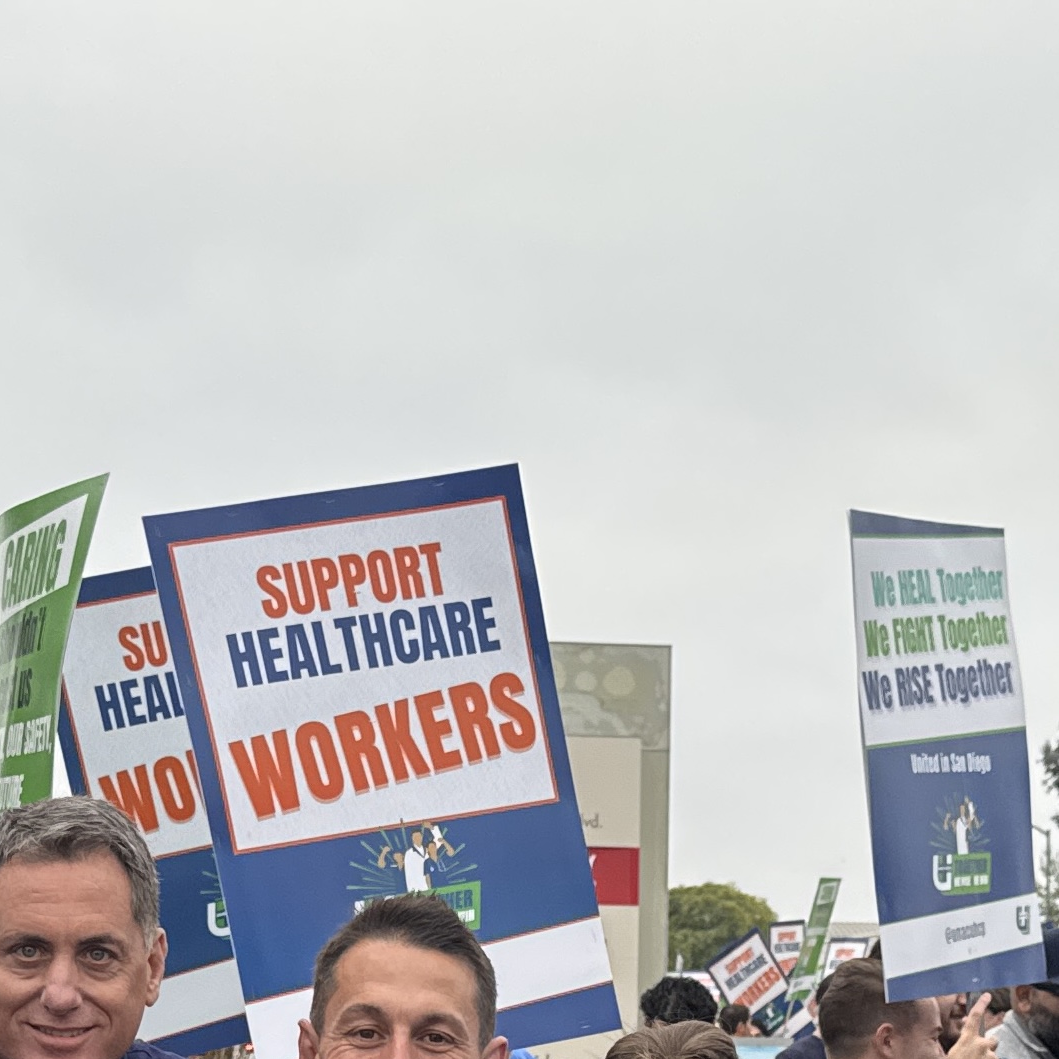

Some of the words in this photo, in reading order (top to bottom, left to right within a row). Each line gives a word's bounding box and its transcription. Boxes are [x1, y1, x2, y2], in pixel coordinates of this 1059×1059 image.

[1, 519, 67, 612] CARING
[256, 542, 444, 620] SUPPORT
[871, 571, 896, 607] We
[898, 569, 936, 606] HEAL
[936, 566, 1003, 606] Together
[226, 597, 502, 689] HEALTHCARE
[863, 619, 890, 657] We
[892, 615, 935, 655] FIGHT
[937, 611, 1009, 653] Together
[862, 670, 893, 711] We
[895, 665, 934, 707] RISE
[934, 658, 1014, 704] Together
[229, 672, 537, 823] WORKERS
[910, 753, 940, 774] United
[950, 753, 967, 773] San
[967, 752, 991, 774] Diego
